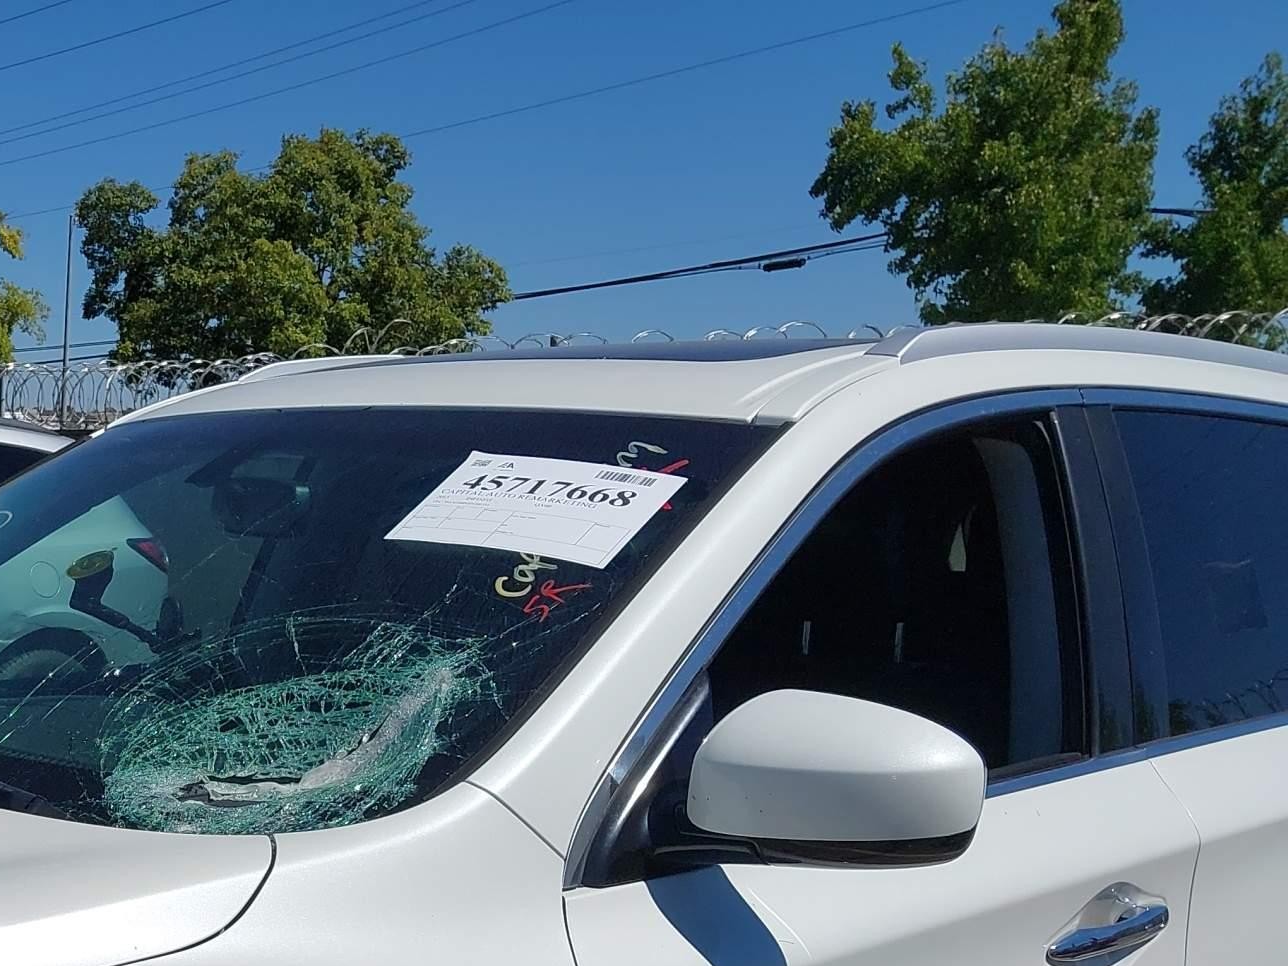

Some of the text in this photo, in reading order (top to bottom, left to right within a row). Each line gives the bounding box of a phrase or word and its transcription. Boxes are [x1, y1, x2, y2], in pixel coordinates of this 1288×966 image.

[441, 488, 485, 497] CAPITAL
[486, 491, 518, 499] AUTO
[519, 494, 597, 509] REMARKETING
[463, 474, 638, 507] 45717668
